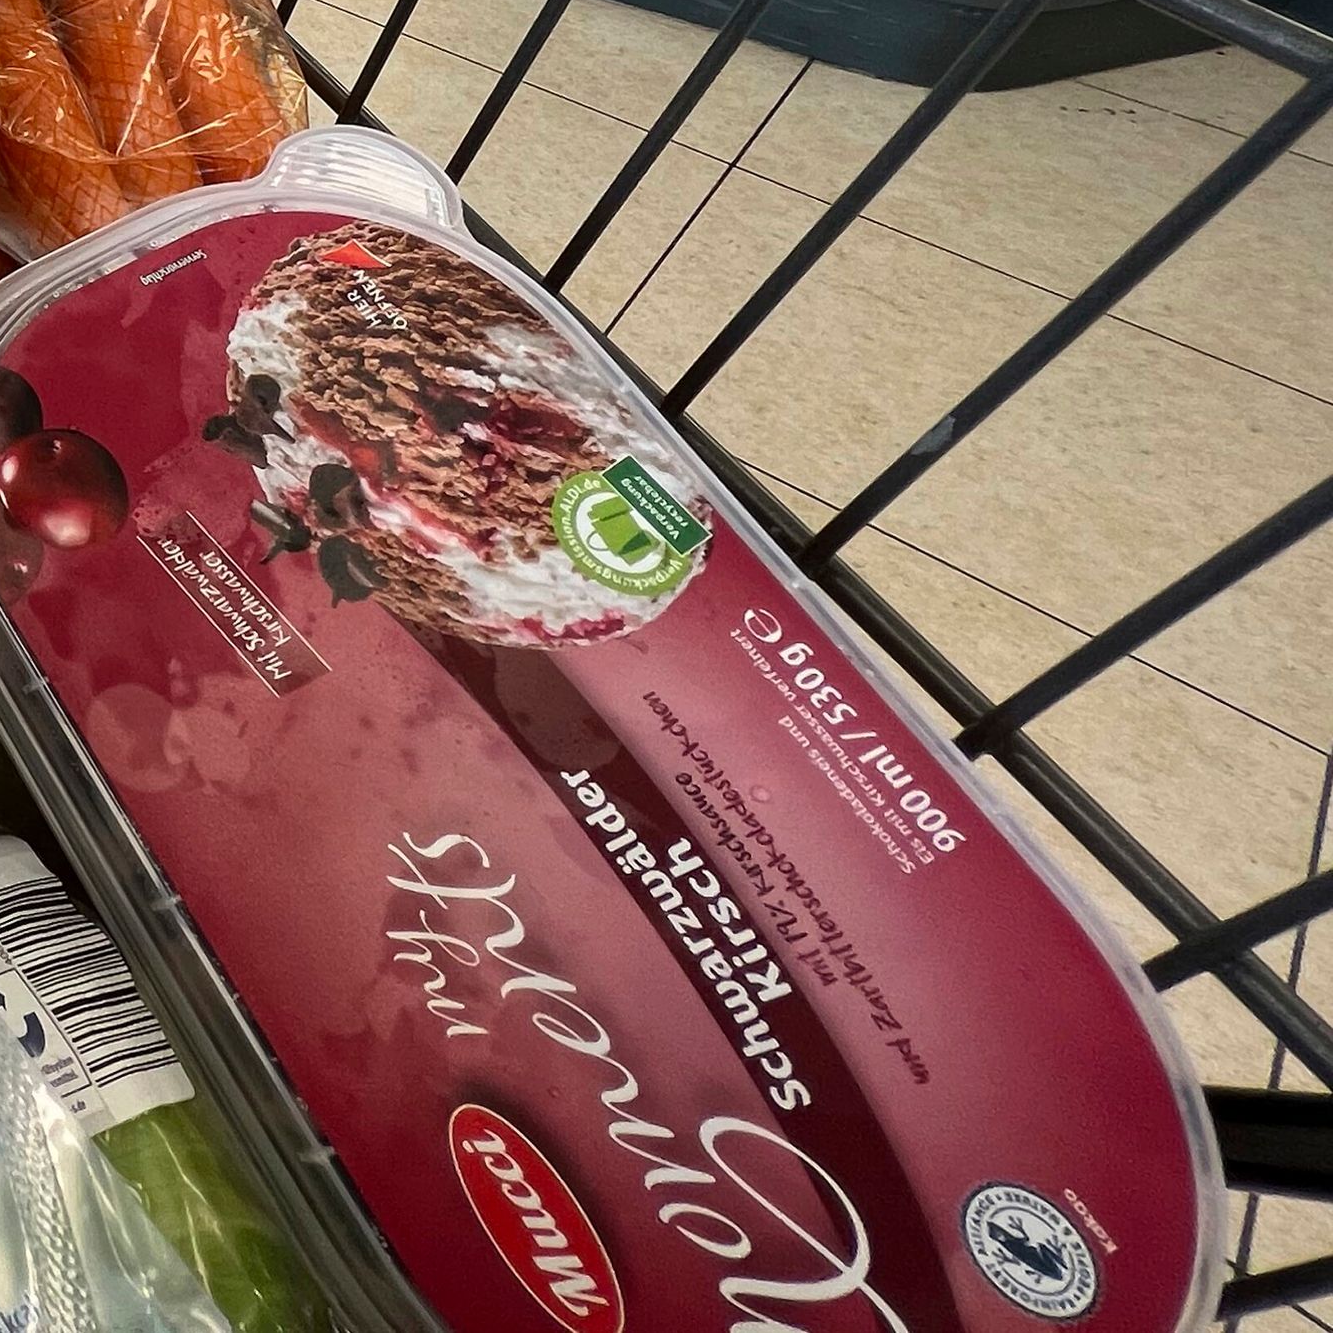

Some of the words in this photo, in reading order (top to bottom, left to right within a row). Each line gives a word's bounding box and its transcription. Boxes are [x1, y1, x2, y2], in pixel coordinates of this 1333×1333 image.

[346, 288, 382, 331] HIER
[634, 474, 689, 528] recyclebar
[156, 537, 266, 653] Schwarzwälder
[198, 549, 292, 648] Kirschwasser
[255, 650, 293, 681] Mit
[729, 627, 797, 702] verfeinert
[777, 714, 811, 747] und
[791, 703, 885, 806] Kirschwasser
[858, 744, 917, 791] ml
[674, 771, 774, 899] Kirschsauce
[806, 745, 918, 876] Schokoladeneis
[885, 807, 912, 837] mit
[898, 789, 968, 854] 900
[908, 836, 936, 866] Eis
[560, 769, 813, 1109] Schwarzwälder
[665, 836, 793, 1005] Kirsch
[797, 947, 839, 988] mit
[885, 1035, 931, 1085] und
[460, 1127, 609, 1319] Mucci
[1063, 1186, 1119, 1255] Kakao
